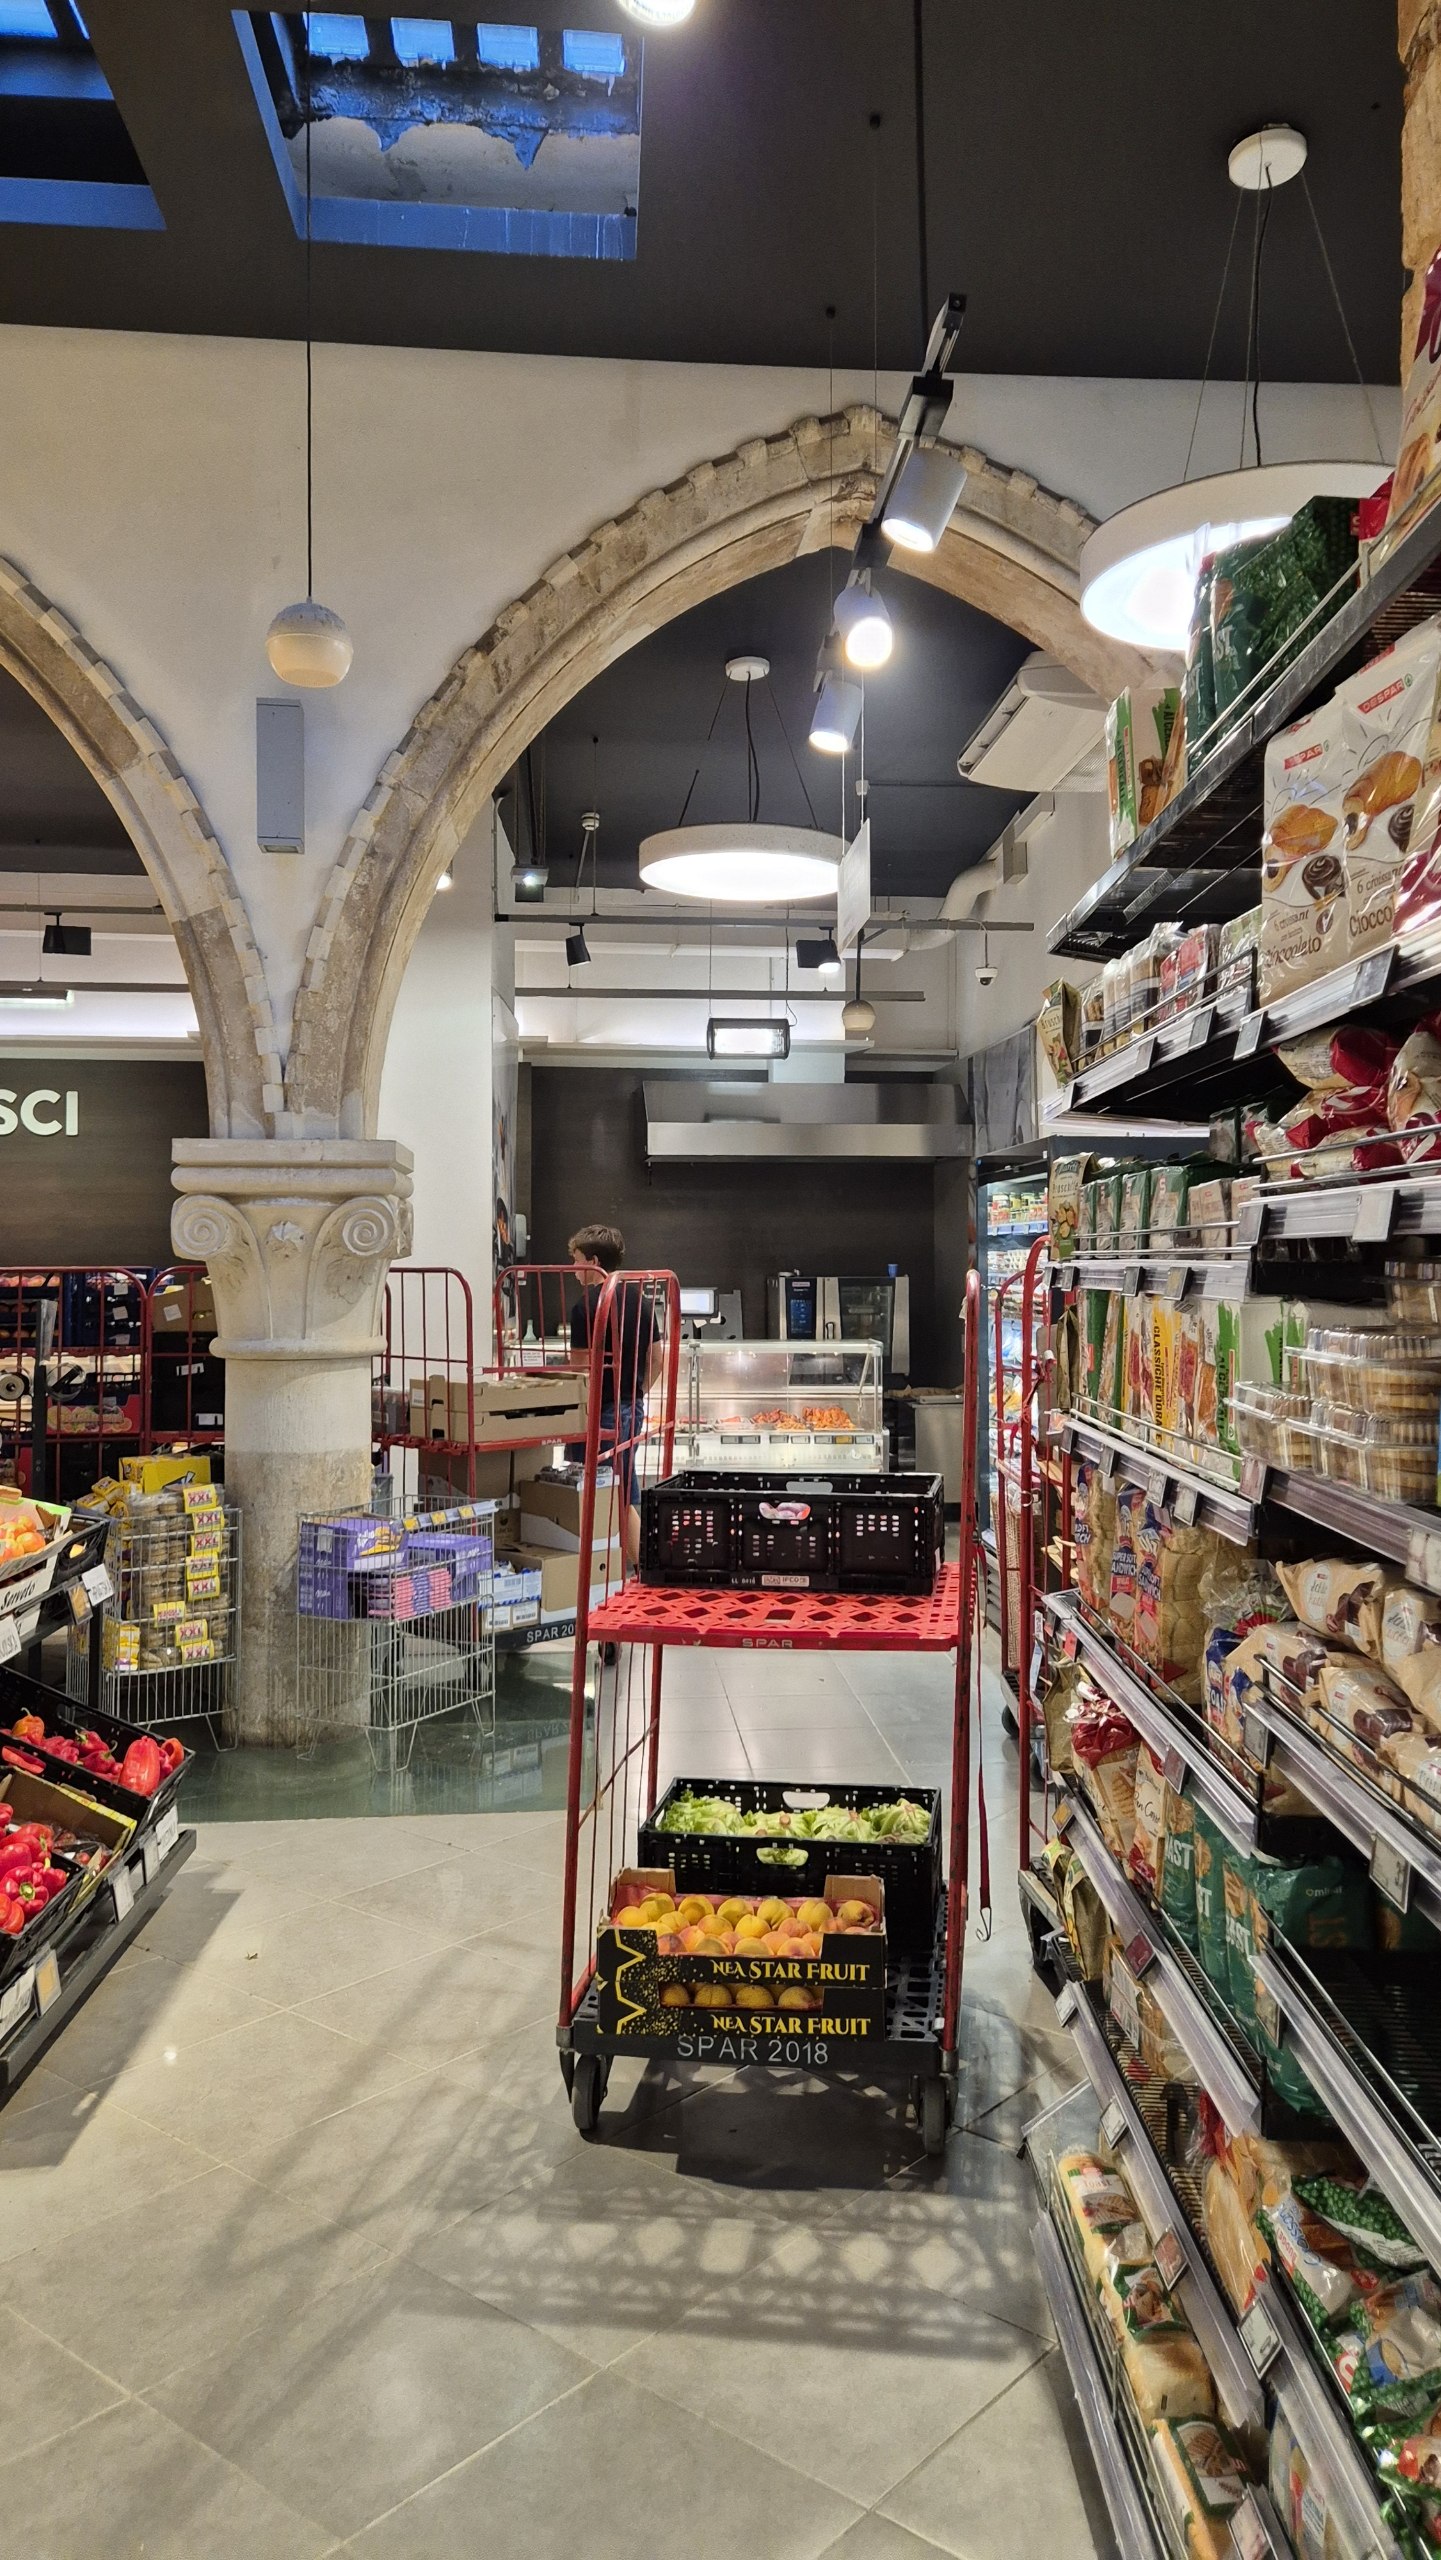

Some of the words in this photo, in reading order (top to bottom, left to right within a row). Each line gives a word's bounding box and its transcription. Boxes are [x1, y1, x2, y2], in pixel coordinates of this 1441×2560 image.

[1360, 680, 1405, 713] DESPAR
[0, 1088, 79, 1136] SCI
[1154, 1325, 1162, 1391] CLASSICHE
[1155, 1394, 1163, 1443] DORAE
[189, 1493, 212, 1504] XXL
[198, 1513, 221, 1525] XXL
[196, 1538, 218, 1549] XXL
[193, 1580, 216, 1592] XXL
[526, 1626, 558, 1643] SPAR
[561, 1623, 577, 1637] 20
[742, 1638, 793, 1648] SPAR
[710, 1958, 747, 1977] NEA
[749, 1960, 804, 1981] STAR
[807, 1962, 871, 1982] FRUIT
[710, 2013, 748, 2033] NEA
[749, 2015, 804, 2036] STAR
[807, 2017, 872, 2036] FRUIT
[677, 2036, 759, 2062] SPAR
[768, 2039, 829, 2065] 2018
